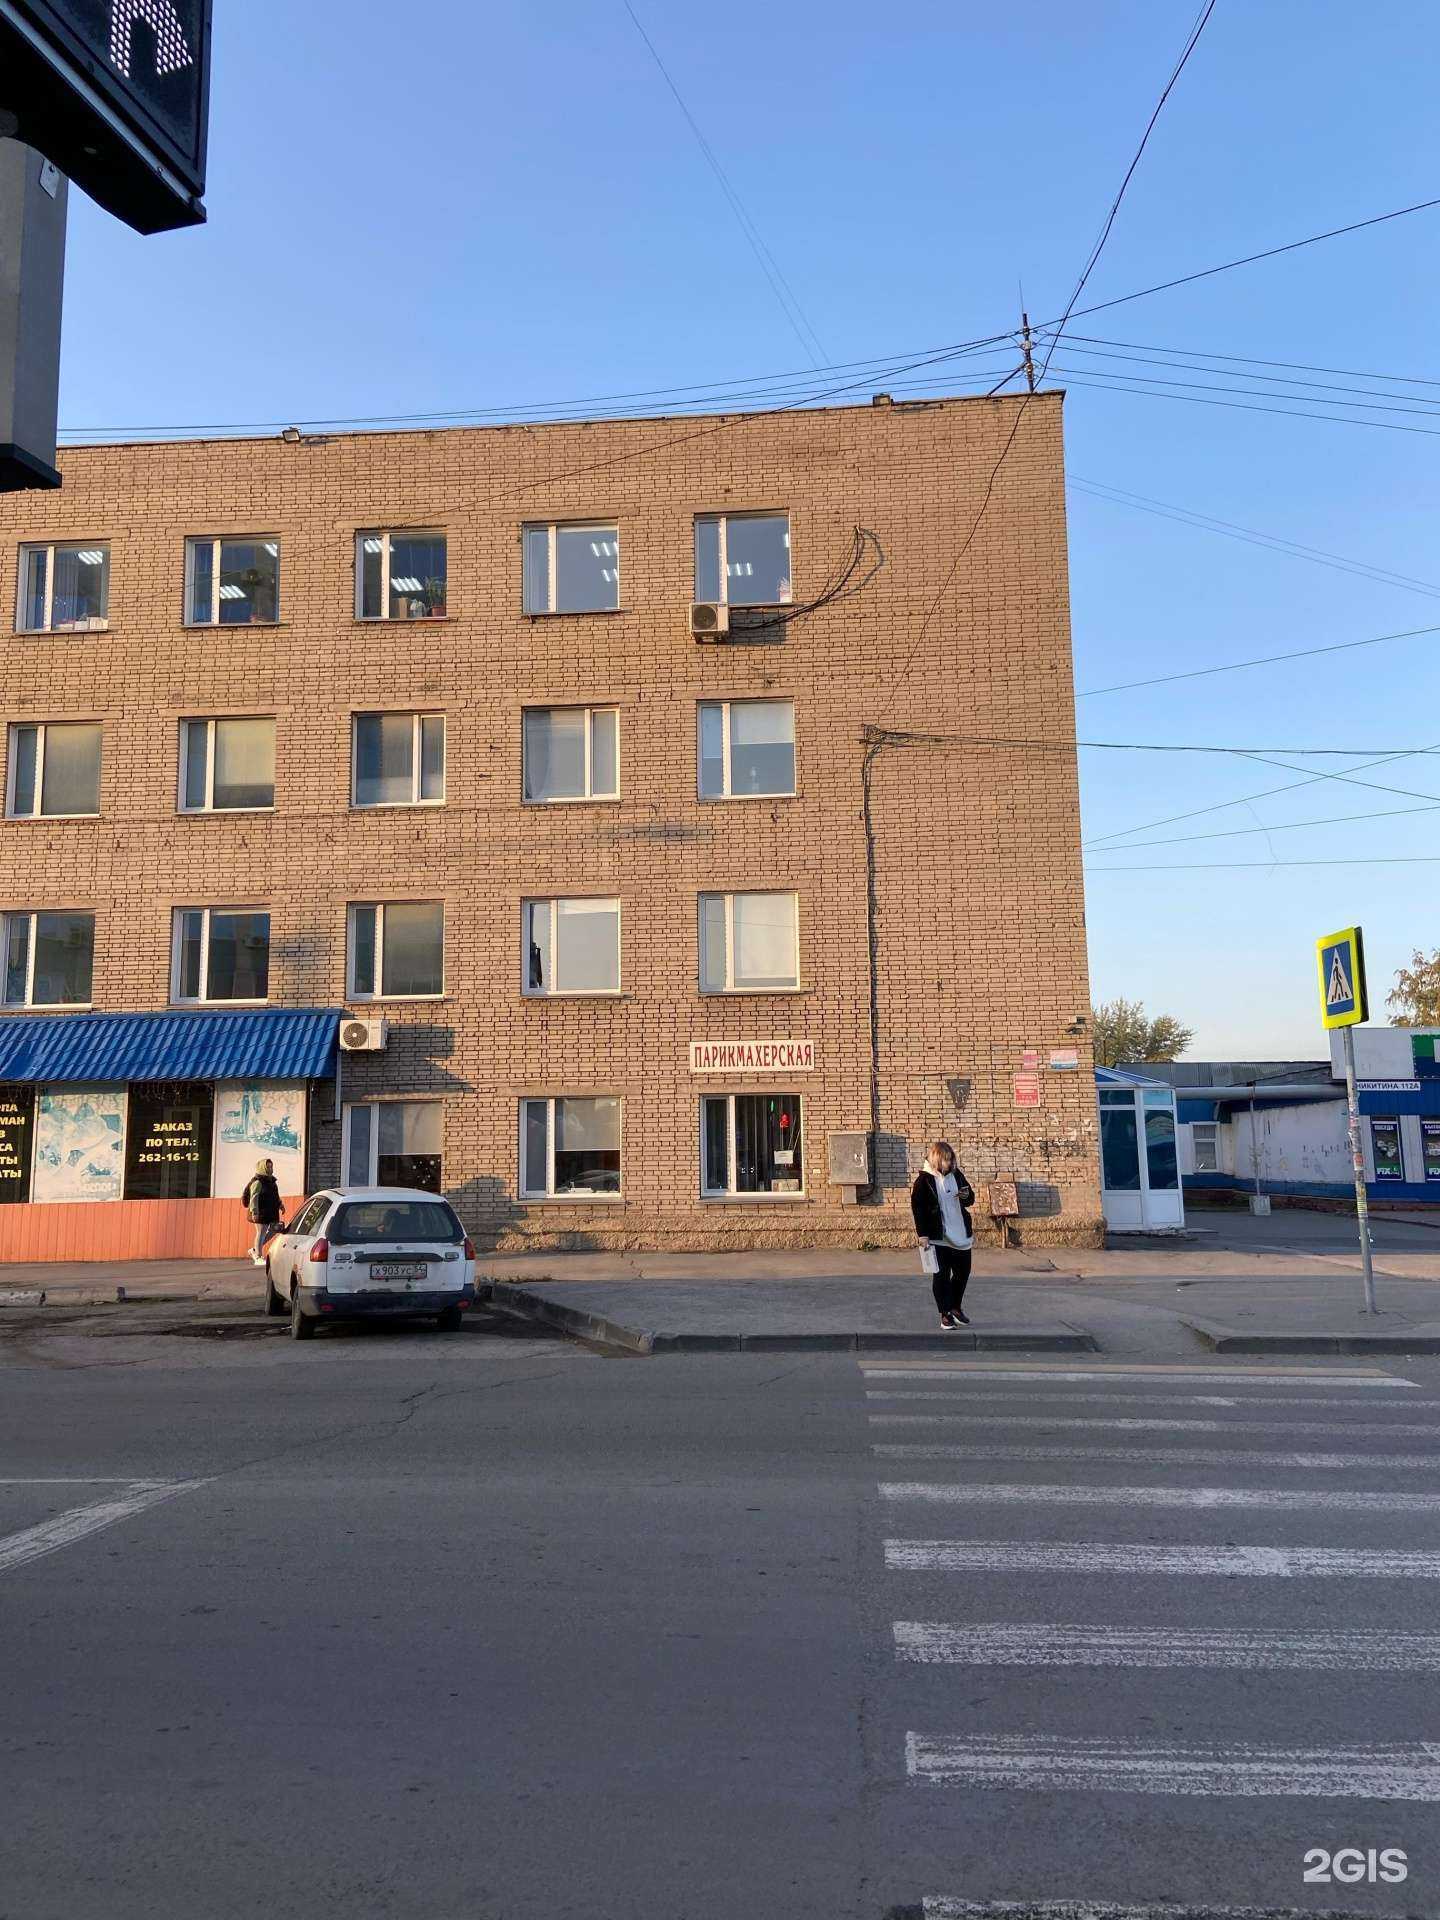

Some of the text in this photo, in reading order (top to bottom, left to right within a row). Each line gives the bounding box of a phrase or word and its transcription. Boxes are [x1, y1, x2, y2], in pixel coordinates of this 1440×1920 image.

[694, 1044, 812, 1067] ПАРИКМАХЕРСКАЯ
[152, 1122, 193, 1132] ЗАКАЗ
[145, 1137, 197, 1147] ПО ТЕЛ.:
[138, 1152, 200, 1163] 262-16-12
[0, 1169, 22, 1178] ТЫ
